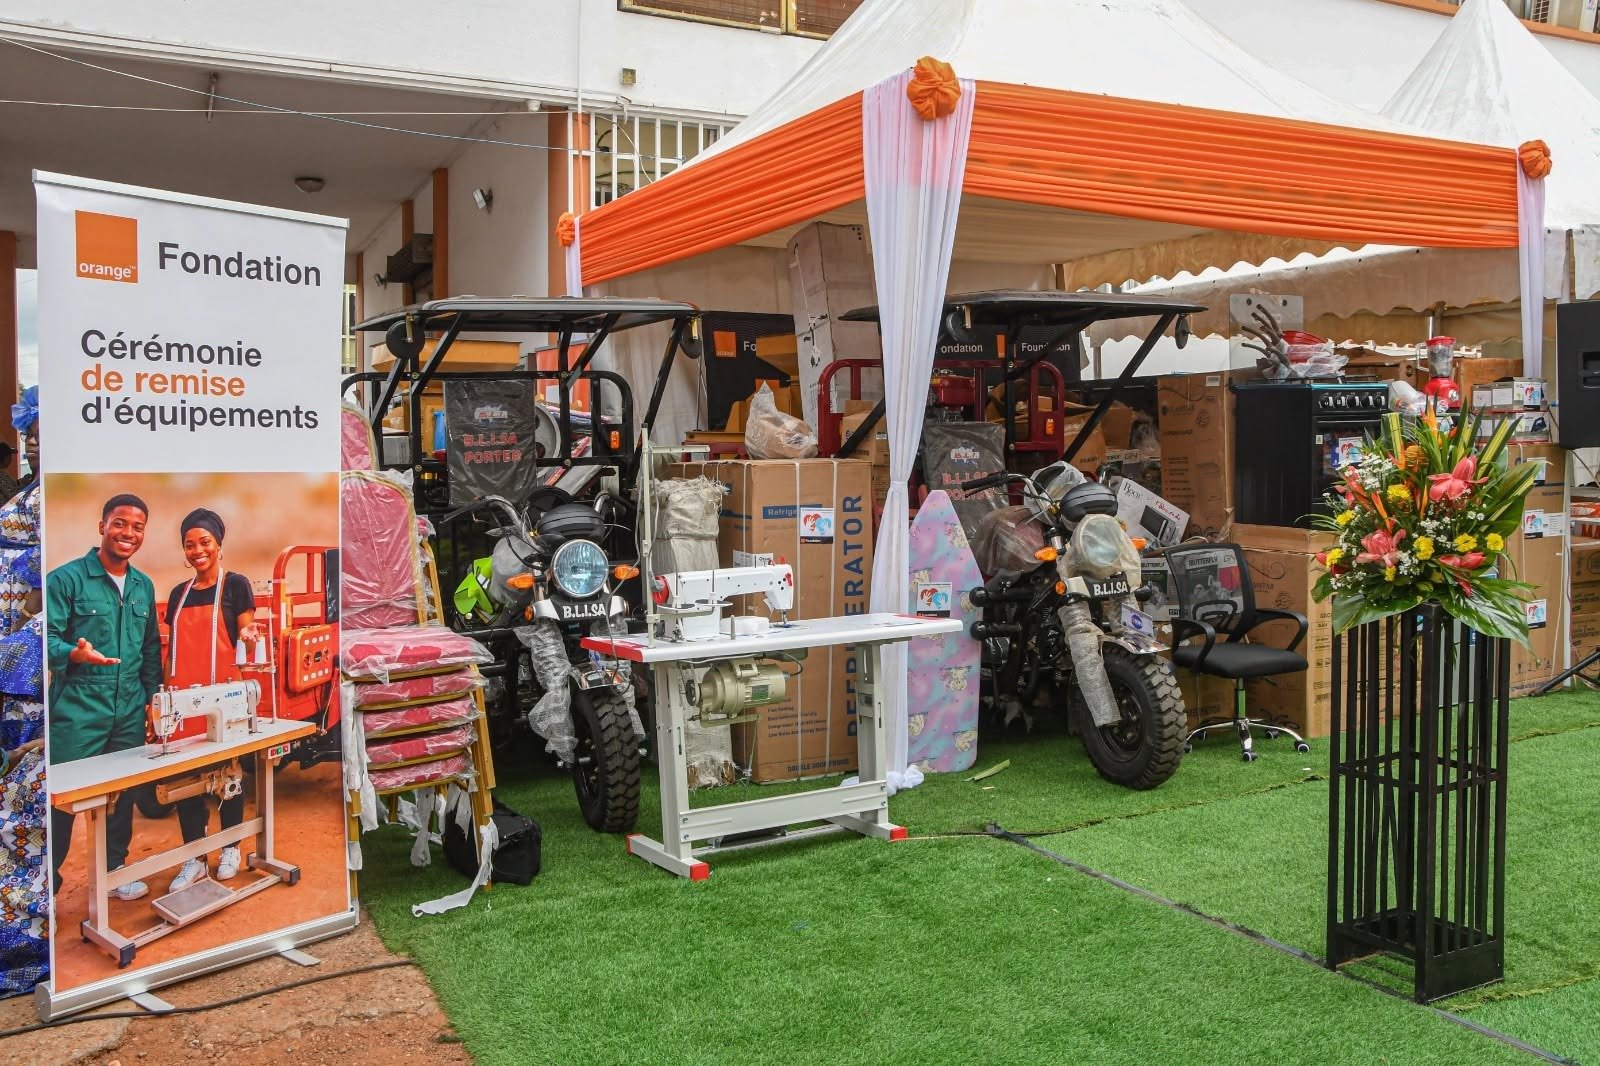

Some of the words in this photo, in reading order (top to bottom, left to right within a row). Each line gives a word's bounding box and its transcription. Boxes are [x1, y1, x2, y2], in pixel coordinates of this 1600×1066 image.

[159, 241, 321, 287] Fondation
[81, 329, 262, 367] Cérémonie
[941, 343, 983, 353] ondation
[81, 363, 123, 392] de
[135, 369, 245, 397] remise
[81, 396, 319, 432] d'équipements
[1093, 580, 1129, 597] B.L.I.SA
[562, 603, 607, 619] B.L.I.SA
